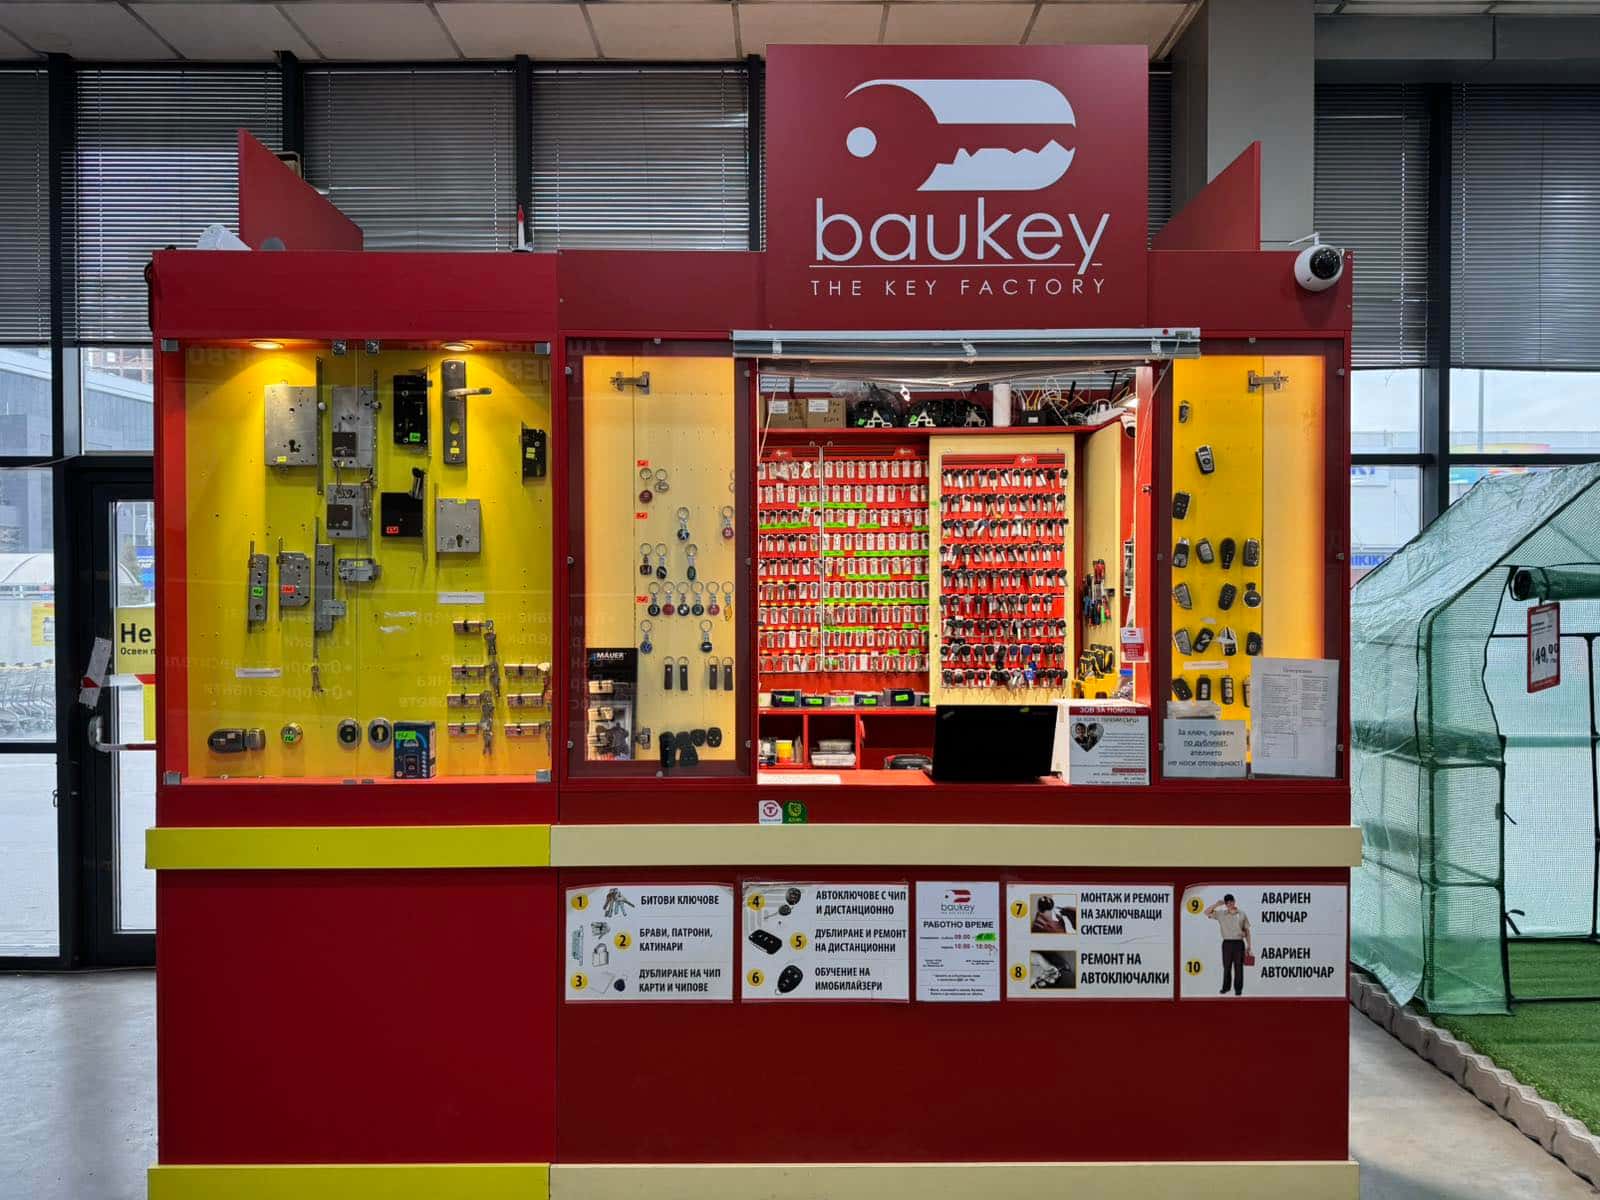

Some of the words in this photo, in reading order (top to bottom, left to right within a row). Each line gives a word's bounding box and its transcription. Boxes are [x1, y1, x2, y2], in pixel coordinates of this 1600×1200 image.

[816, 197, 1110, 275] baukey
[811, 280, 863, 296] THE
[885, 279, 938, 296] KEY
[960, 278, 1105, 296] FACTORY
[597, 652, 624, 660] MAUER
[640, 895, 676, 905] БИТОВИ
[677, 895, 720, 905] КЛЮЧОВЕ
[752, 895, 760, 907] 4
[816, 891, 880, 900] АВТОКЛЮЧОВЕ
[881, 891, 887, 900] С
[888, 891, 906, 900] ЧИП
[1081, 893, 1121, 903] МОНТАЖ
[1124, 893, 1130, 903] И
[1132, 893, 1170, 903] РЕМОНТ
[1261, 892, 1311, 904] АВАРИЕН
[577, 896, 582, 907] 1
[1191, 900, 1199, 911] 9
[816, 905, 823, 914] И
[824, 905, 894, 916] ДИСТАНЦИОННО
[1015, 903, 1022, 915] 7
[1081, 909, 1093, 919] НА
[1095, 909, 1162, 920] ЗАКЛЮЧВАЩИ
[1261, 911, 1307, 923] КЛЮЧАР
[639, 928, 670, 938] БРАВИ,
[671, 928, 713, 938] ПАТРОНИ,
[815, 929, 864, 939] ДУБЛИРАНЕ
[866, 929, 872, 938] И
[873, 929, 906, 938] РЕМОНТ
[1081, 925, 1122, 935] СИСТЕМИ
[619, 935, 627, 947] 2
[795, 935, 802, 947] 5
[639, 943, 683, 952] КАТИНАРИ
[815, 943, 827, 952] НА
[828, 943, 896, 953] ДИСТАНЦИОННИ
[1081, 953, 1125, 965] РЕМОНТ
[1127, 953, 1141, 965] НА
[1261, 948, 1310, 959] АВАРИЕН
[815, 967, 857, 977] ОБУЧЕНИЕ
[859, 967, 870, 977] НА
[1015, 966, 1022, 978] 8
[1187, 961, 1200, 973] 10
[1261, 966, 1334, 978] АВТОКЛЮЧАР
[639, 969, 688, 979] ДУБЛИРАНЕ
[690, 969, 701, 978] НА
[703, 968, 721, 978] ЧИП
[752, 972, 760, 984] 6
[1081, 972, 1169, 984] АВТОКЛЮЧАЛКИ
[575, 975, 582, 988] 3
[815, 980, 883, 991] ИМОБИЛАЙЗЕРИ
[639, 983, 665, 992] КАРТИ
[667, 983, 674, 992] И
[675, 983, 708, 992] ЧИПОВЕ
